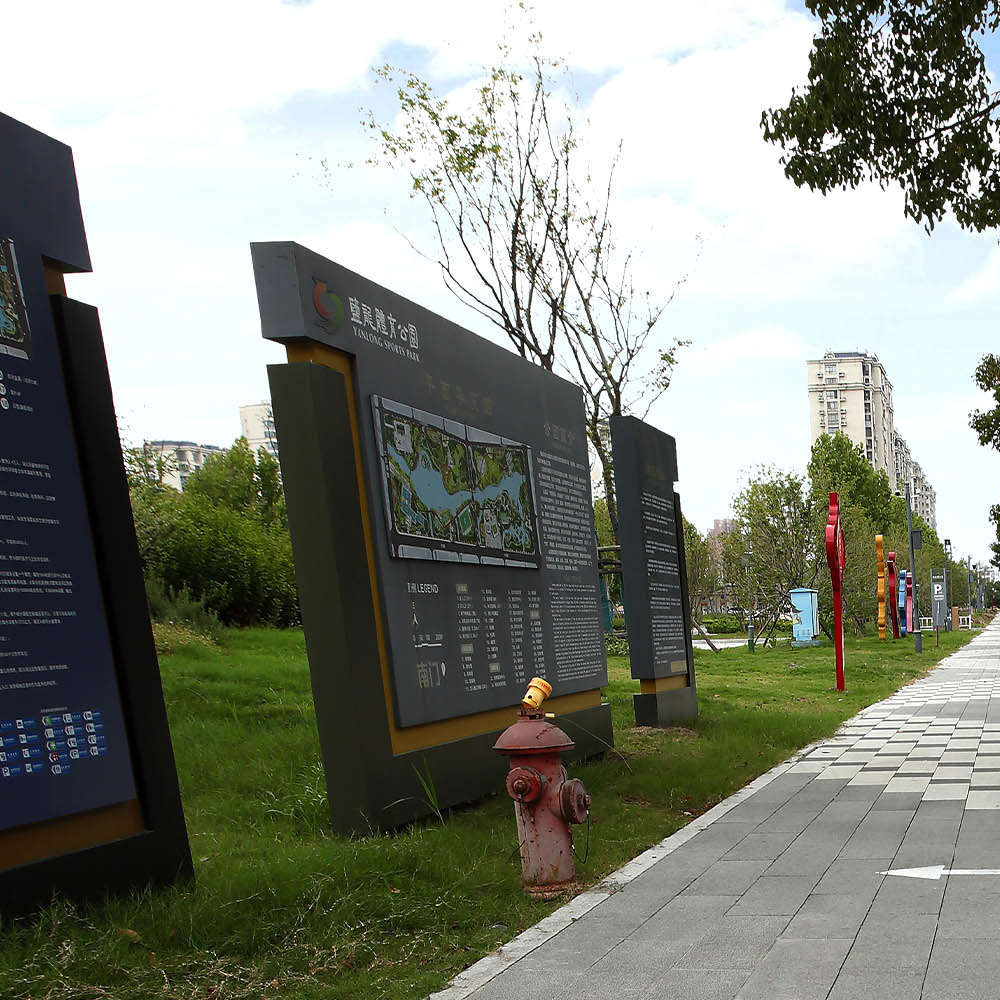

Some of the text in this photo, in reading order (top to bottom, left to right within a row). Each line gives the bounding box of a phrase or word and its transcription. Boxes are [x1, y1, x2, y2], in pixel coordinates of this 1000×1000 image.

[384, 340, 405, 358] SPORTS
[406, 349, 420, 362] PARK
[417, 583, 439, 594] LEGEND
